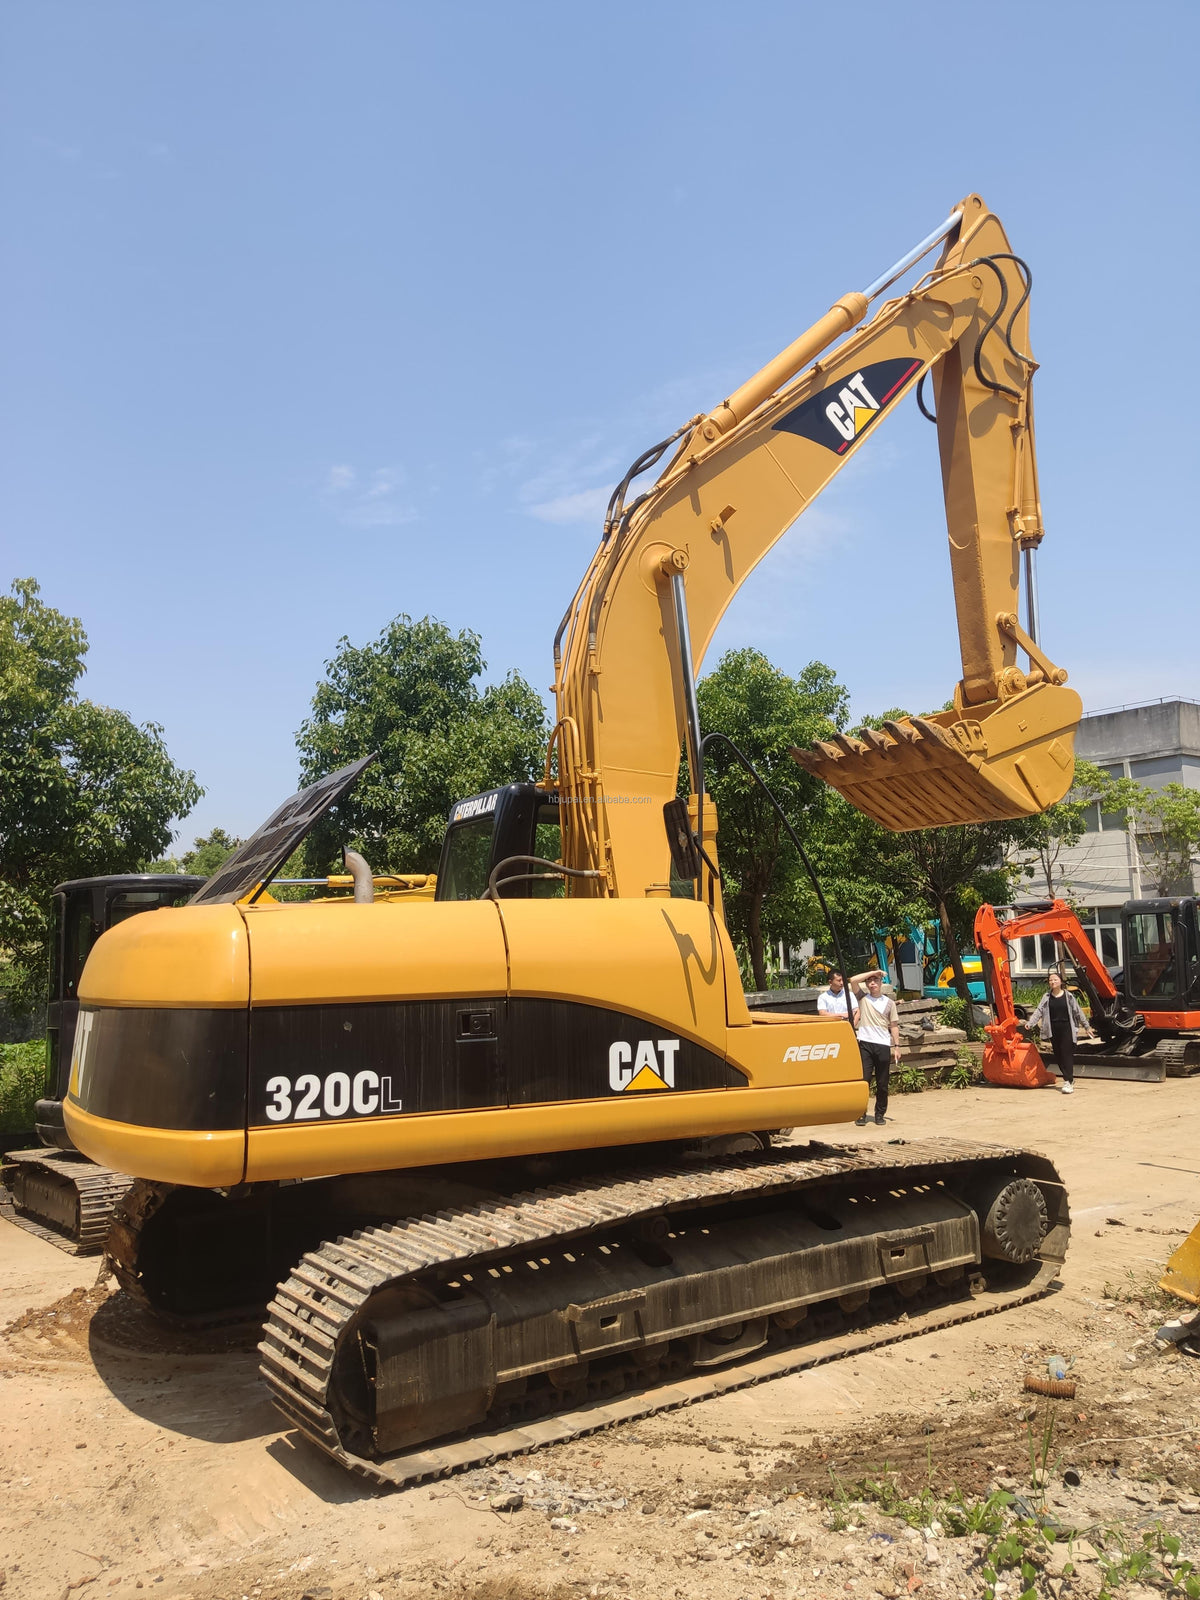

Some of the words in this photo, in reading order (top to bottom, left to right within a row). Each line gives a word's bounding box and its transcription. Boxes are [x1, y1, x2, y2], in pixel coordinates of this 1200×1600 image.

[825, 372, 881, 441] CAT
[453, 793, 499, 822] CATERPILLAR
[608, 1039, 680, 1092] CAT
[782, 1043, 841, 1063] REGA
